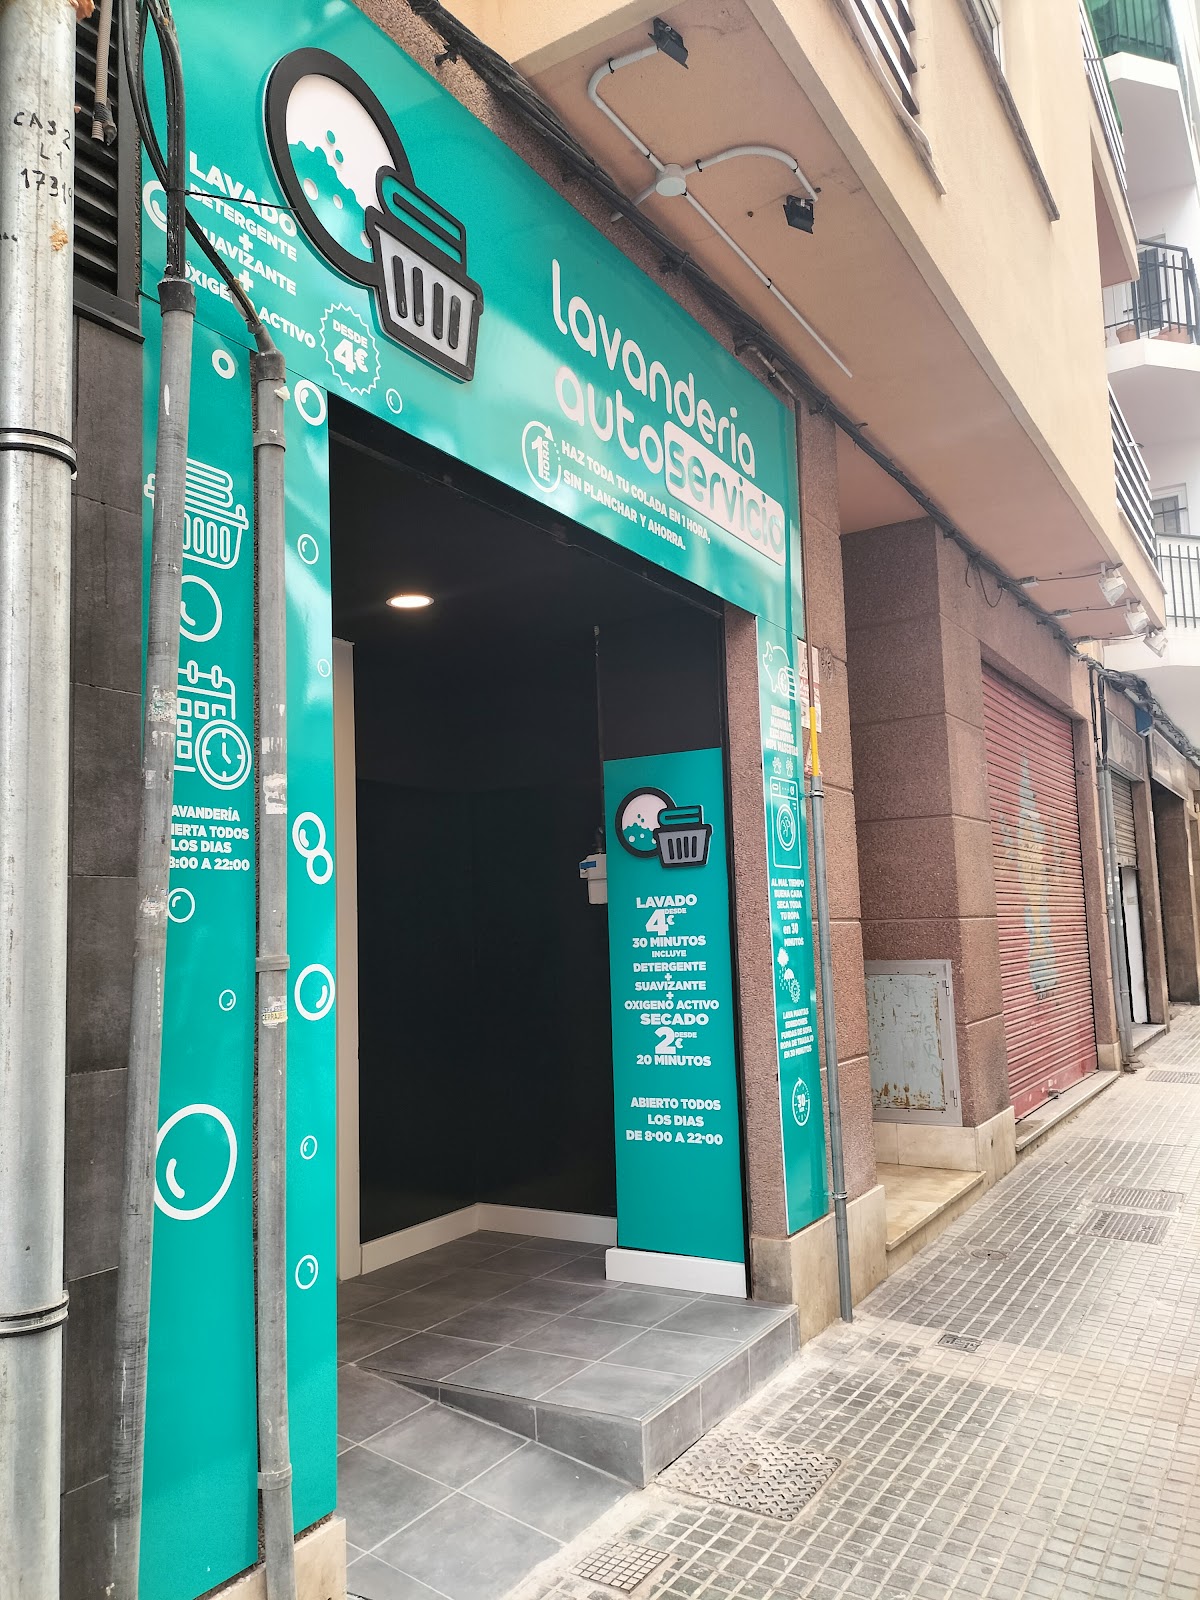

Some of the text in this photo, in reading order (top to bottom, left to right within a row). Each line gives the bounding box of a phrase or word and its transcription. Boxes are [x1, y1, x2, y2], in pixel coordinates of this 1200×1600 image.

[189, 150, 297, 237] LAVADO
[189, 182, 297, 262] DETERGENTE
[199, 226, 297, 297] UAVIZANTE
[258, 306, 316, 349] ACTIVO
[332, 319, 368, 347] DESDE
[333, 339, 370, 374] 4€
[552, 258, 756, 479] lavanderia
[561, 439, 585, 463] HAZ
[586, 454, 614, 481] TODA
[616, 474, 630, 494] TU
[631, 482, 667, 514] COLADA
[668, 507, 681, 526] EN
[687, 518, 711, 544] HORA,
[563, 469, 687, 551] SIN PLANCHAR Y AHORRA.
[171, 804, 241, 822] AVANDERÍA
[171, 823, 250, 840] IERTA TODOS
[171, 838, 233, 854] LOS DIAS
[200, 857, 212, 870] A
[213, 857, 250, 871] 22:00
[636, 894, 698, 908] LAVADO
[665, 907, 687, 915] DESDE
[791, 922, 799, 935] 30
[632, 935, 707, 949] 30 MINUTOS
[651, 949, 687, 958] INCLUYE
[633, 961, 707, 973] DETERGENTE
[635, 980, 707, 992] SUAVIZANTE
[624, 999, 720, 1011] OXIGENO ACTIVO
[640, 1013, 710, 1026] SECADO
[674, 1031, 698, 1039] DESDE
[636, 1054, 712, 1067] 20 MINUTOS
[630, 1096, 721, 1111] ABIERTO TODOS
[647, 1114, 704, 1127] LOS DIAS
[625, 1130, 643, 1142] DE
[674, 1131, 685, 1143] A
